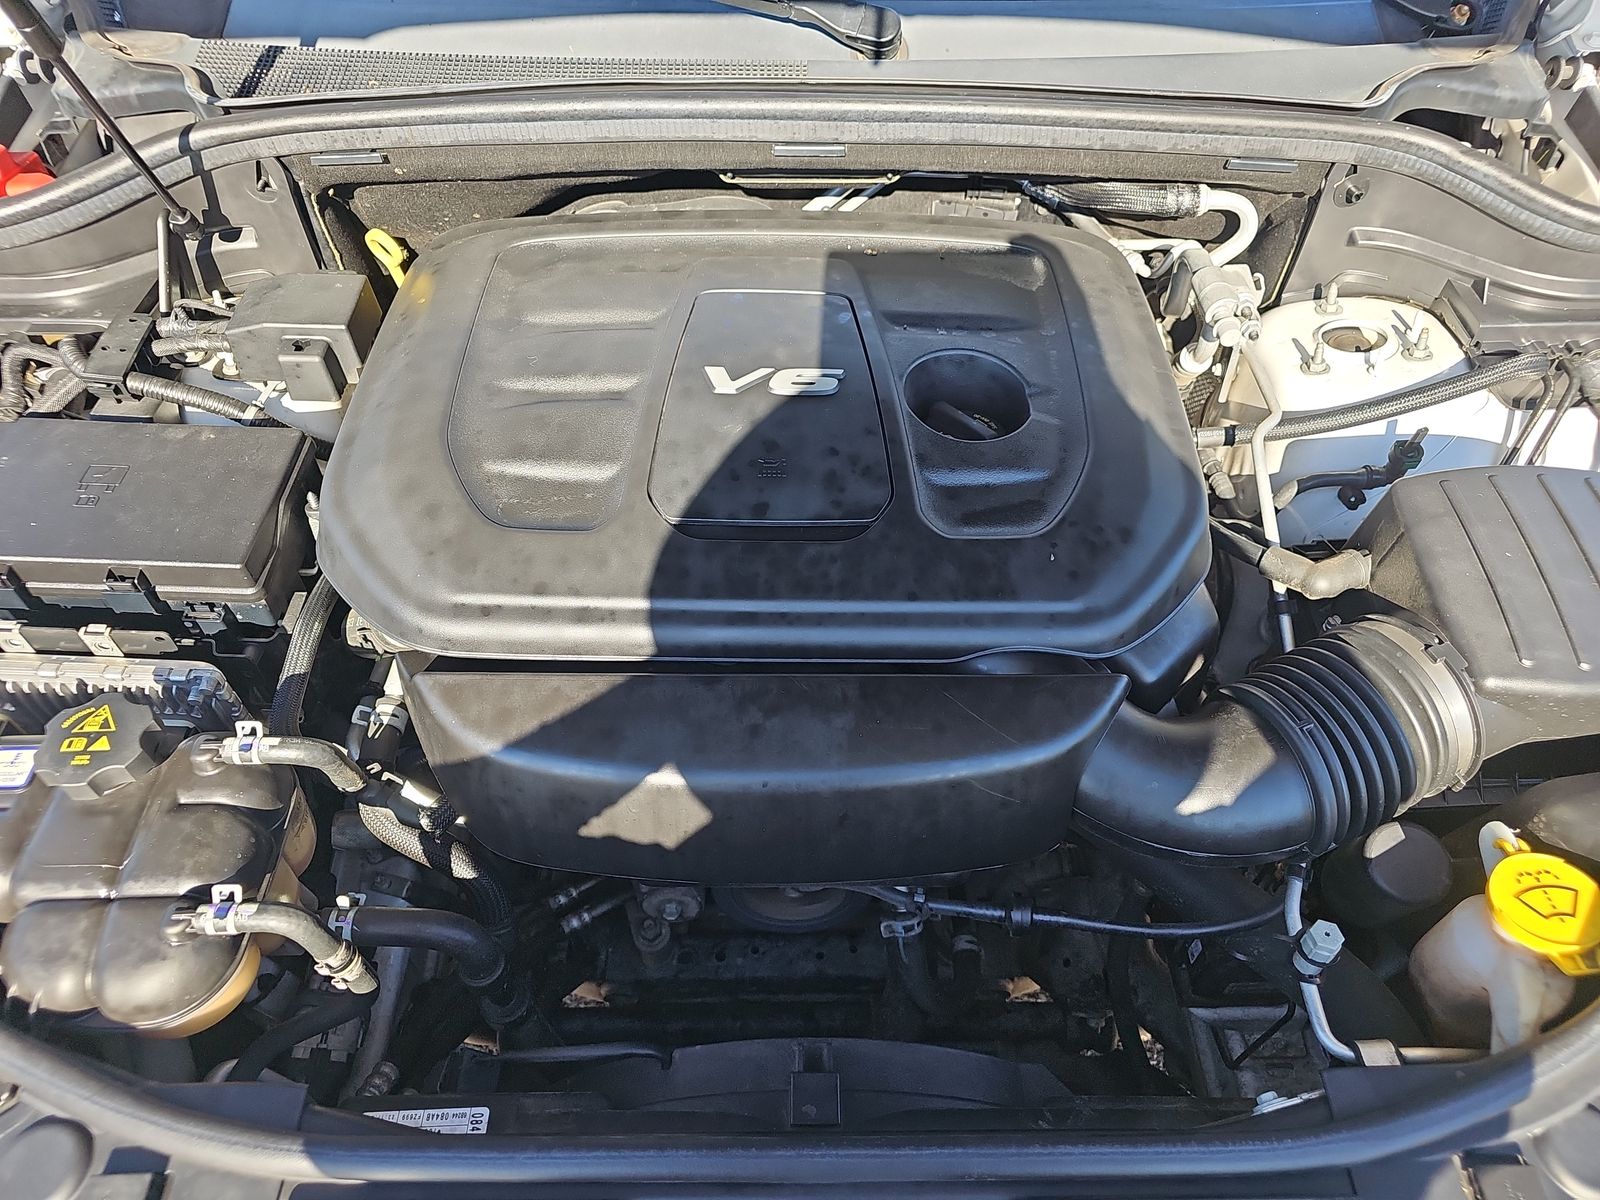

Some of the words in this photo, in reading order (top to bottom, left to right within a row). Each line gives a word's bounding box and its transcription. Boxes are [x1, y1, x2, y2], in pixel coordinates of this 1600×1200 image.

[703, 365, 846, 396] V6
[426, 1112, 449, 1122] 084AB
[469, 1112, 485, 1132] 084
